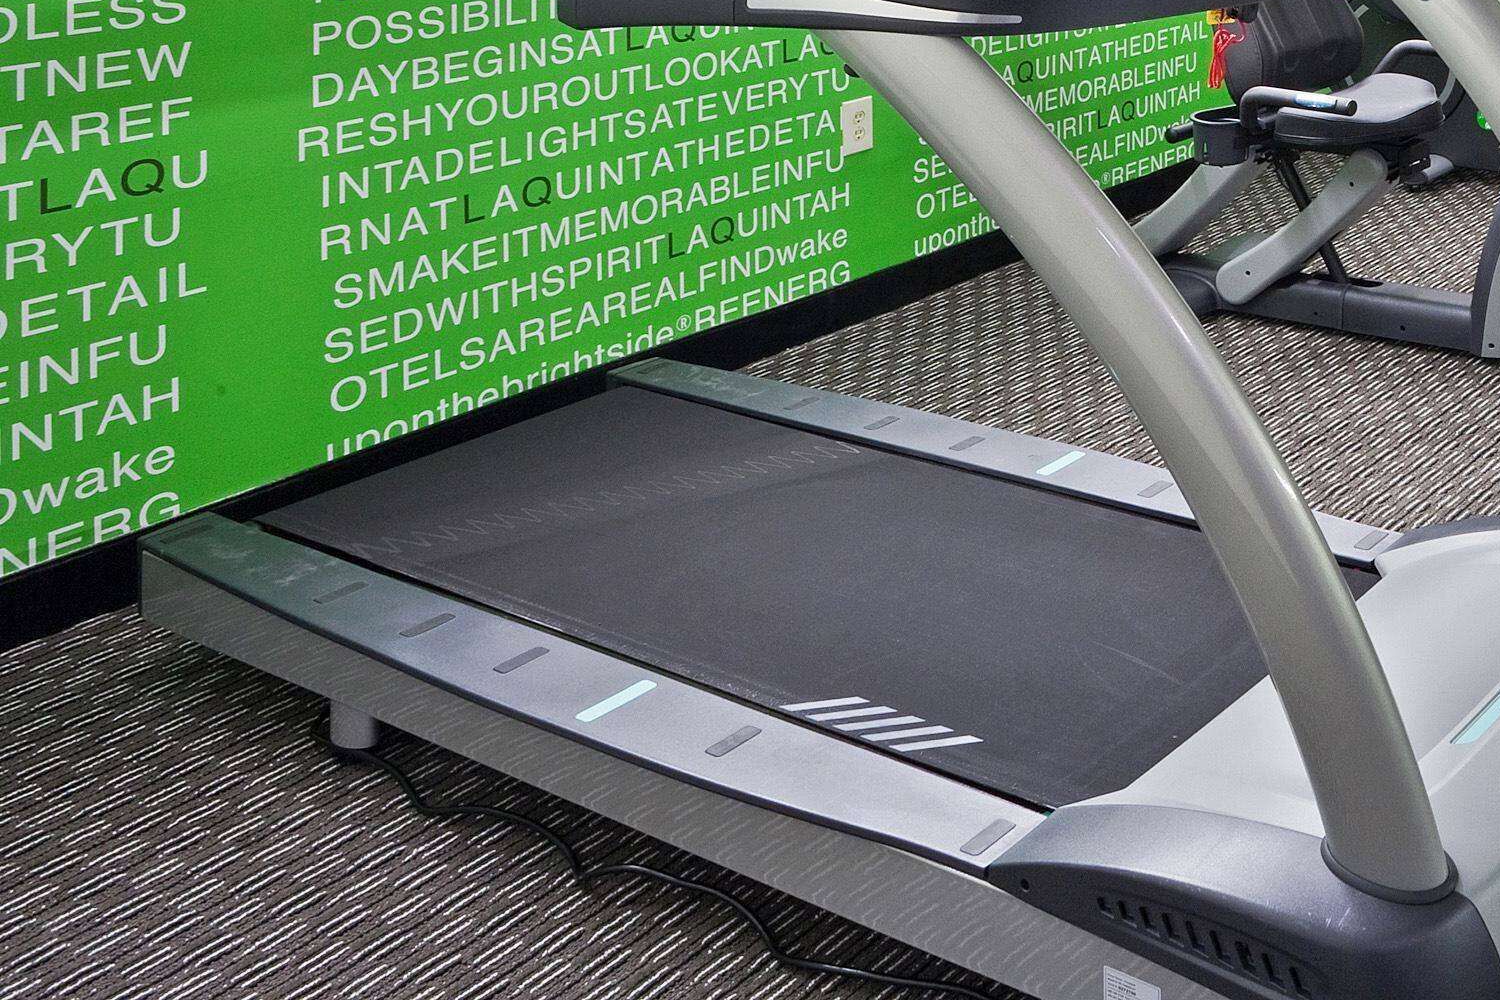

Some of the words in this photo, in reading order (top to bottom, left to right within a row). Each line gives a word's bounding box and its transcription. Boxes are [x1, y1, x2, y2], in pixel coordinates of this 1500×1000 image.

[0, 41, 193, 102] TNEW
[1020, 51, 1198, 114] MEMORABLEINFU
[0, 149, 208, 222] TLAQU
[913, 153, 953, 184] SE
[5, 207, 181, 281] RYTU
[324, 182, 852, 365] SEDWITHSPIRITLAQUINTAH
[0, 262, 208, 341] ETAIL
[330, 225, 848, 413] OTELSAREAREALFINDwake
